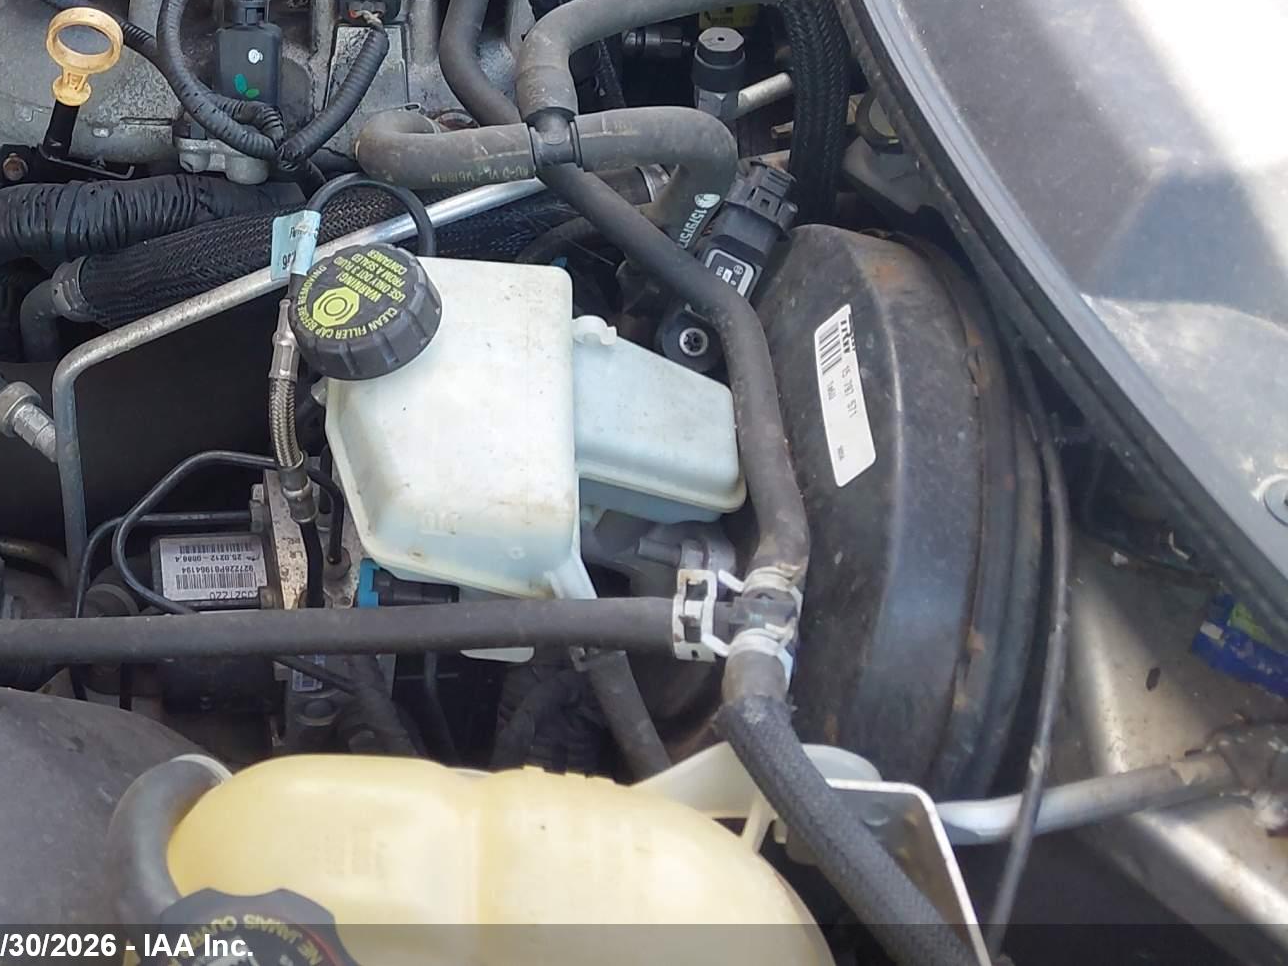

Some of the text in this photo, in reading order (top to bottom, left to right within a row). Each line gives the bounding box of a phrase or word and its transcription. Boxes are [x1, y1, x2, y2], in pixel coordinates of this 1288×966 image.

[351, 253, 379, 272] SEALED
[366, 249, 408, 275] CONTAINER
[357, 268, 373, 283] DOT
[369, 275, 393, 295] ONLY
[382, 269, 406, 288] FROM
[335, 272, 383, 304] WARNING!
[386, 286, 407, 304] USE
[297, 264, 398, 340] CLEAN FILLER CAP BEFORE REMOVING
